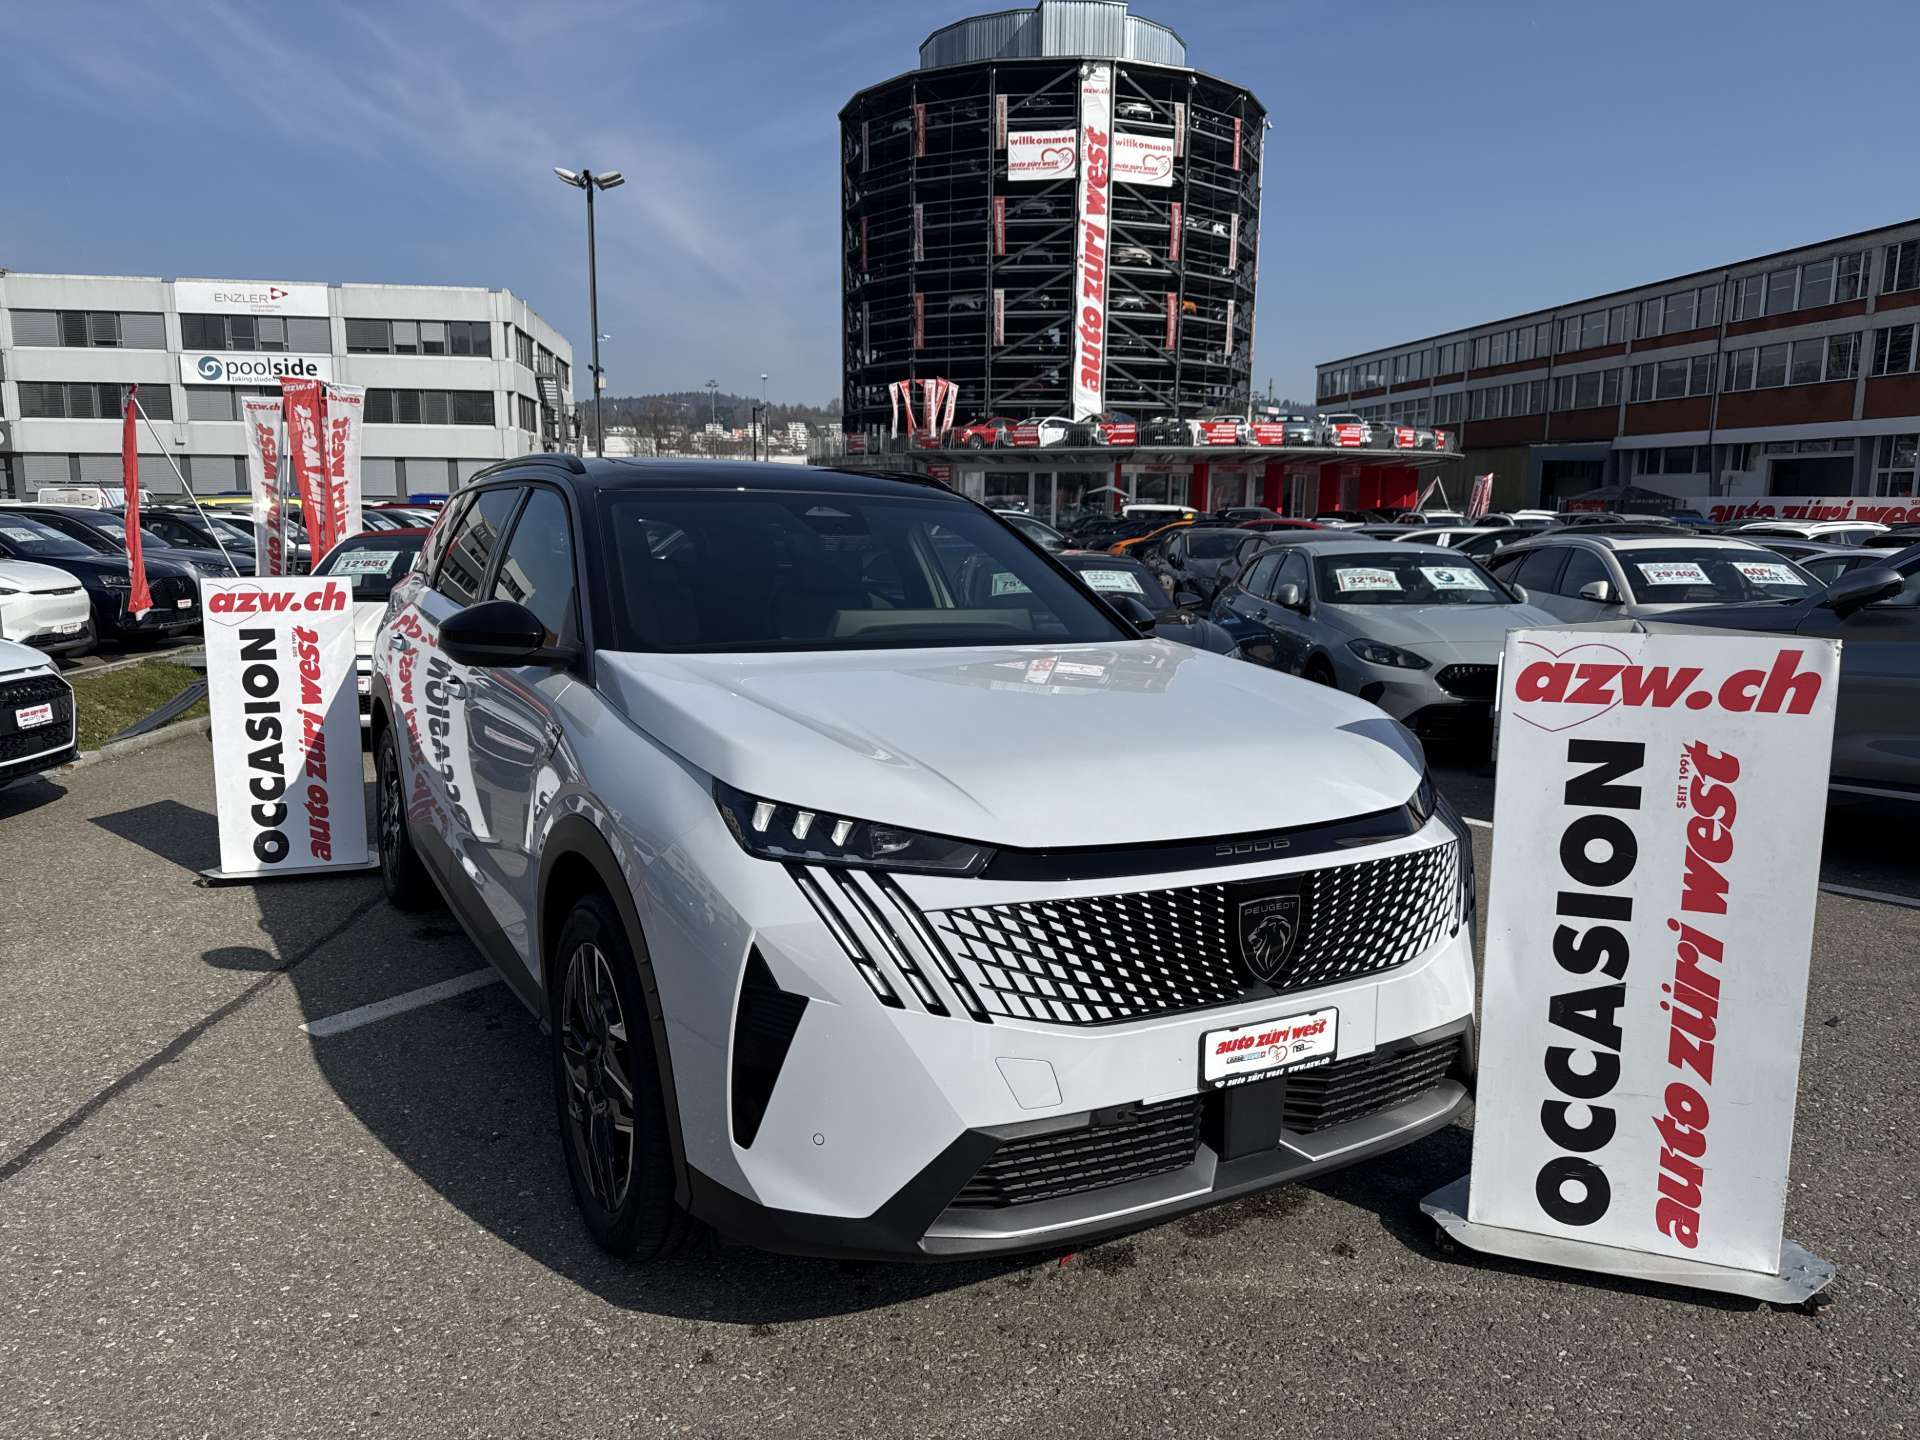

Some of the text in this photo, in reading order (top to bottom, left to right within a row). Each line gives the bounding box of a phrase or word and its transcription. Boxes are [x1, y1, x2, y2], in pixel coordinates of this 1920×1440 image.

[1009, 136, 1075, 145] willkommen
[1115, 138, 1172, 152] willkommen
[1078, 125, 1109, 393] auto züri west
[214, 293, 269, 304] ENZLER
[226, 357, 318, 382] poolside
[246, 402, 281, 411] azw.ch
[256, 423, 279, 480] west
[294, 404, 322, 468] west
[1709, 500, 1920, 526] auto züri wes
[266, 537, 282, 577] uto
[209, 582, 346, 613] azw.ch
[1515, 649, 1822, 715] azw.ch
[239, 628, 290, 863] OCCASION
[292, 625, 332, 862] auto züri west
[1676, 753, 1691, 809] SEIT 1991
[1244, 901, 1297, 916] PEUGEOT
[1535, 738, 1646, 1227] OCCASION
[1652, 739, 1741, 1249] auto züri west
[1215, 1018, 1328, 1056] auto züri west
[1227, 1077, 1246, 1087] auto
